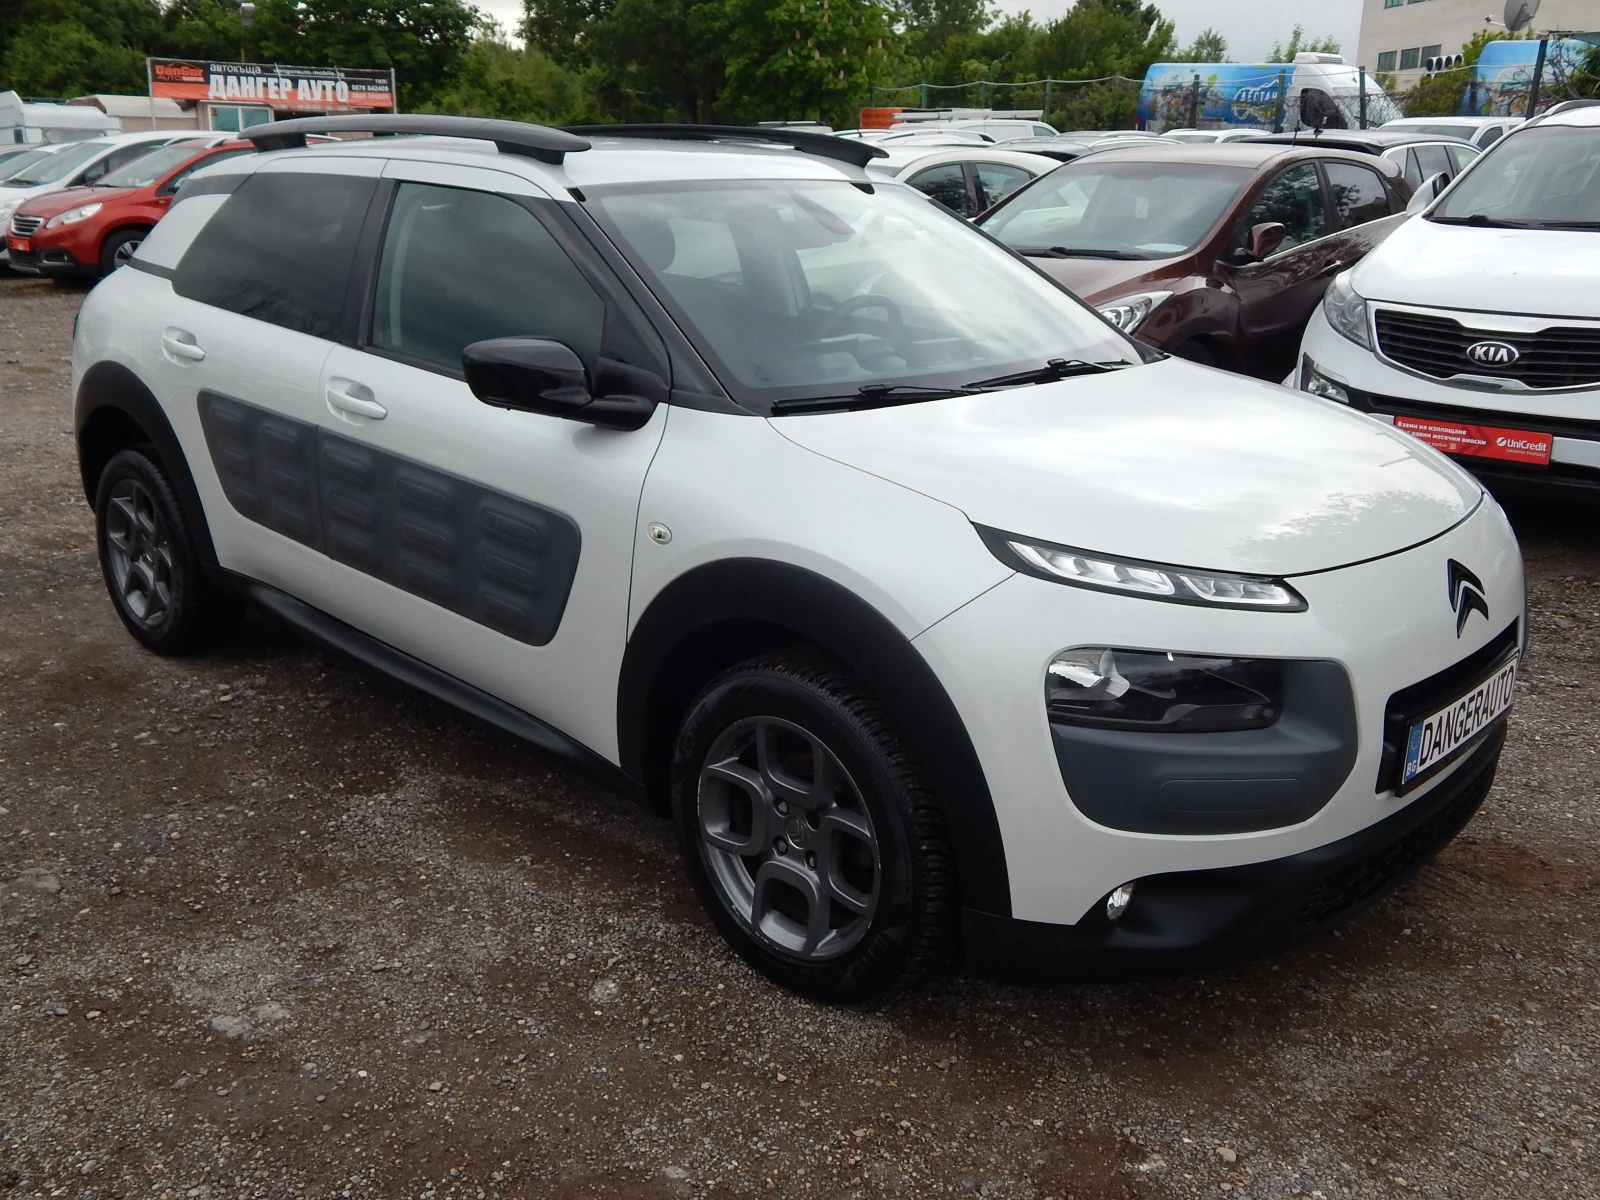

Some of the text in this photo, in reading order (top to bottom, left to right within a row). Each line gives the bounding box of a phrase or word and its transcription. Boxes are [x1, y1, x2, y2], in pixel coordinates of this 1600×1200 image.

[209, 63, 262, 75] автокъща
[208, 74, 349, 103] ДАНГЕР АУТО
[1474, 345, 1509, 363] KIA
[1397, 420, 1418, 430] Вземи
[1428, 426, 1467, 436] изплащане
[1461, 437, 1487, 446] вноски
[1507, 438, 1547, 452] UniCredit
[1418, 664, 1515, 768] DANGERAUTO
[1406, 759, 1418, 777] BG
